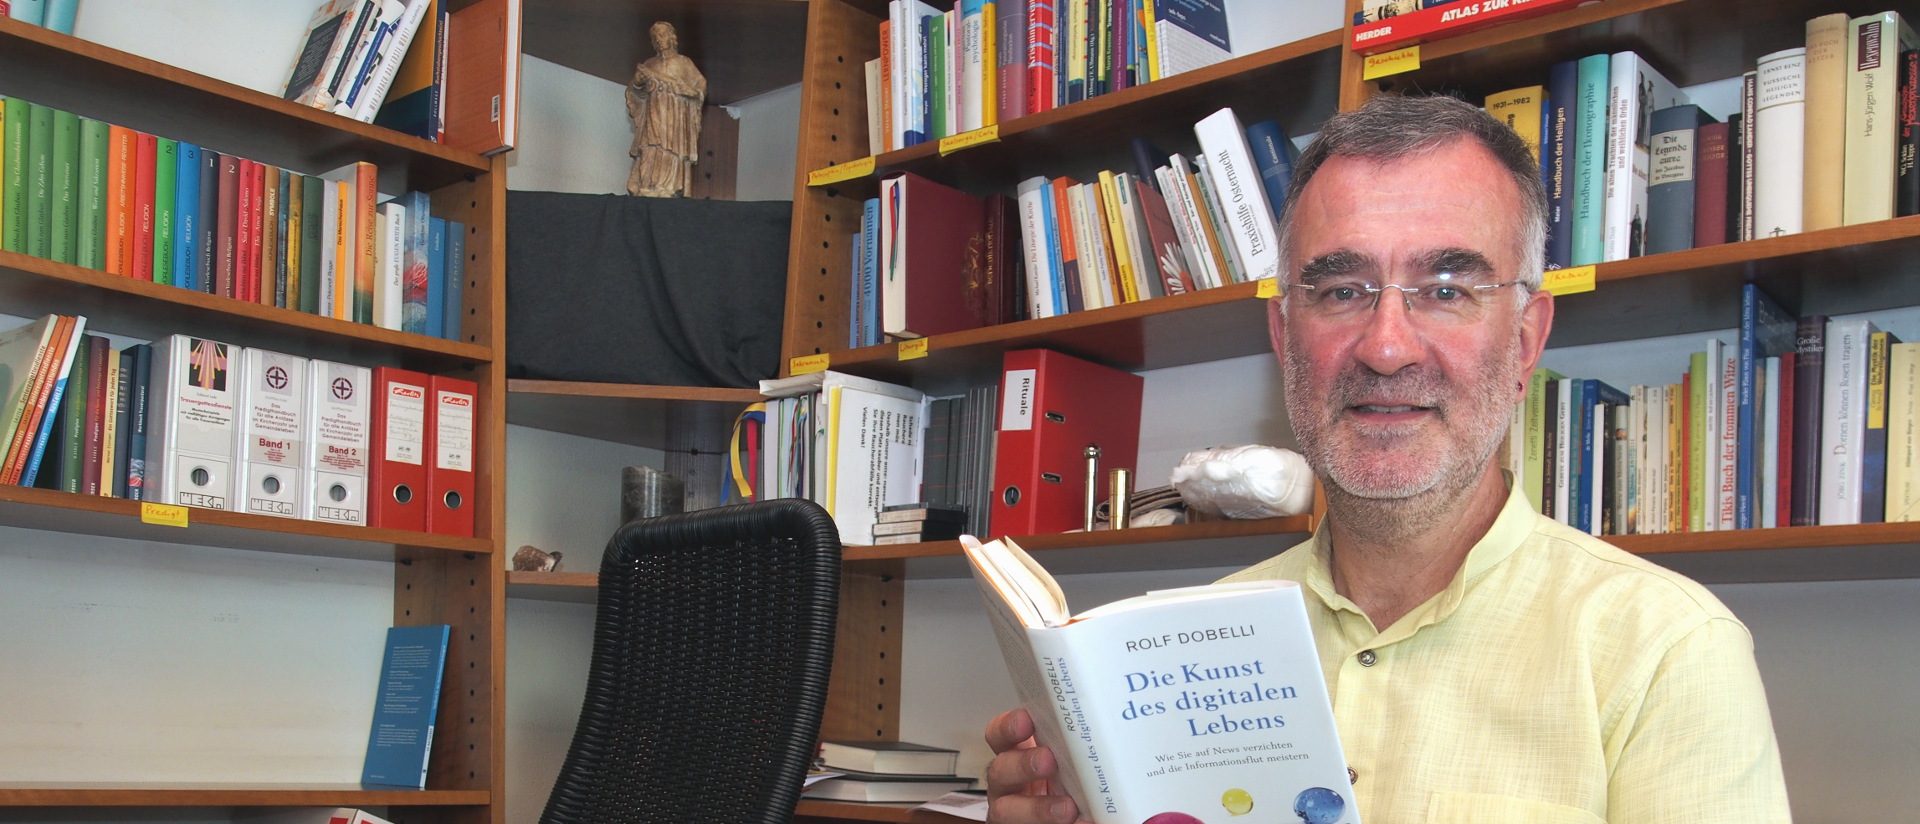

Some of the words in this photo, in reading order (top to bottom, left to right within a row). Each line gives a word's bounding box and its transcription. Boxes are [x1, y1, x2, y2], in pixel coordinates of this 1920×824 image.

[1356, 26, 1392, 42] HERDER
[1441, 4, 1480, 23] ATLAS
[881, 29, 890, 82] LERNPOWER
[972, 20, 981, 64] psychologie
[1762, 66, 1783, 75] ERNST
[1865, 73, 1876, 97] Wolf
[1763, 90, 1801, 102] LEGENDEN
[1555, 107, 1566, 142] Heiligen
[1583, 83, 1597, 149] Ikonographie
[1864, 97, 1876, 138] Hans-Jürgen
[165, 145, 172, 154] 2
[188, 150, 194, 159] 3
[209, 158, 214, 168] 1
[1554, 142, 1563, 157] der
[1581, 150, 1591, 167] der
[228, 164, 235, 174] 2
[1217, 149, 1244, 203] Osternacht
[1553, 157, 1563, 199] Handbuch
[367, 175, 375, 203] Sonne
[1580, 168, 1591, 219] Handbuch
[142, 203, 150, 233] RELIGION
[366, 219, 374, 241] Reise
[1236, 203, 1263, 257] Praxishilfe
[864, 206, 873, 266] Vornamen
[863, 266, 873, 297] 4000
[1796, 335, 1821, 345] Große
[1842, 334, 1853, 361] tragen
[1724, 358, 1737, 389] Witze
[1840, 363, 1850, 387] Rosen
[1019, 377, 1030, 417] Rituale
[1530, 374, 1541, 432] Zeitvermehrung
[1838, 389, 1849, 420] können
[1723, 391, 1736, 440] frommen
[259, 437, 283, 449] Band
[286, 442, 291, 450] 1
[328, 445, 349, 456] Band
[351, 448, 357, 456] 2
[1529, 435, 1538, 462] Zenetti
[1722, 442, 1735, 461] der
[1833, 422, 1849, 455] Dornen
[869, 434, 877, 482] Raucherabfälle
[1722, 464, 1735, 493] Buch
[1721, 496, 1735, 525] Tikis
[1125, 634, 1172, 653] ROLF
[1177, 624, 1256, 645] DOBELLI
[1043, 656, 1064, 707] DOBELLI
[1056, 656, 1075, 693] Lebens
[1123, 671, 1176, 694] Die
[1180, 657, 1266, 685] Kunst
[1121, 700, 1167, 721] des
[1174, 685, 1299, 713] digitalen
[1064, 708, 1076, 732] ROLF
[1071, 693, 1093, 744] digitalen
[1186, 712, 1287, 737] Lebens
[1087, 743, 1100, 764] des
[1146, 764, 1166, 778] und
[1168, 763, 1184, 775] die
[1185, 755, 1265, 772] Informationsflut
[1266, 751, 1310, 765] meistern
[1155, 752, 1175, 763] Wie
[1177, 749, 1193, 761] Sie
[1195, 747, 1211, 759] auf
[1212, 744, 1241, 756] News
[1242, 740, 1294, 754] verzichten
[1091, 765, 1111, 795] Kunst
[1104, 796, 1118, 814] Die
